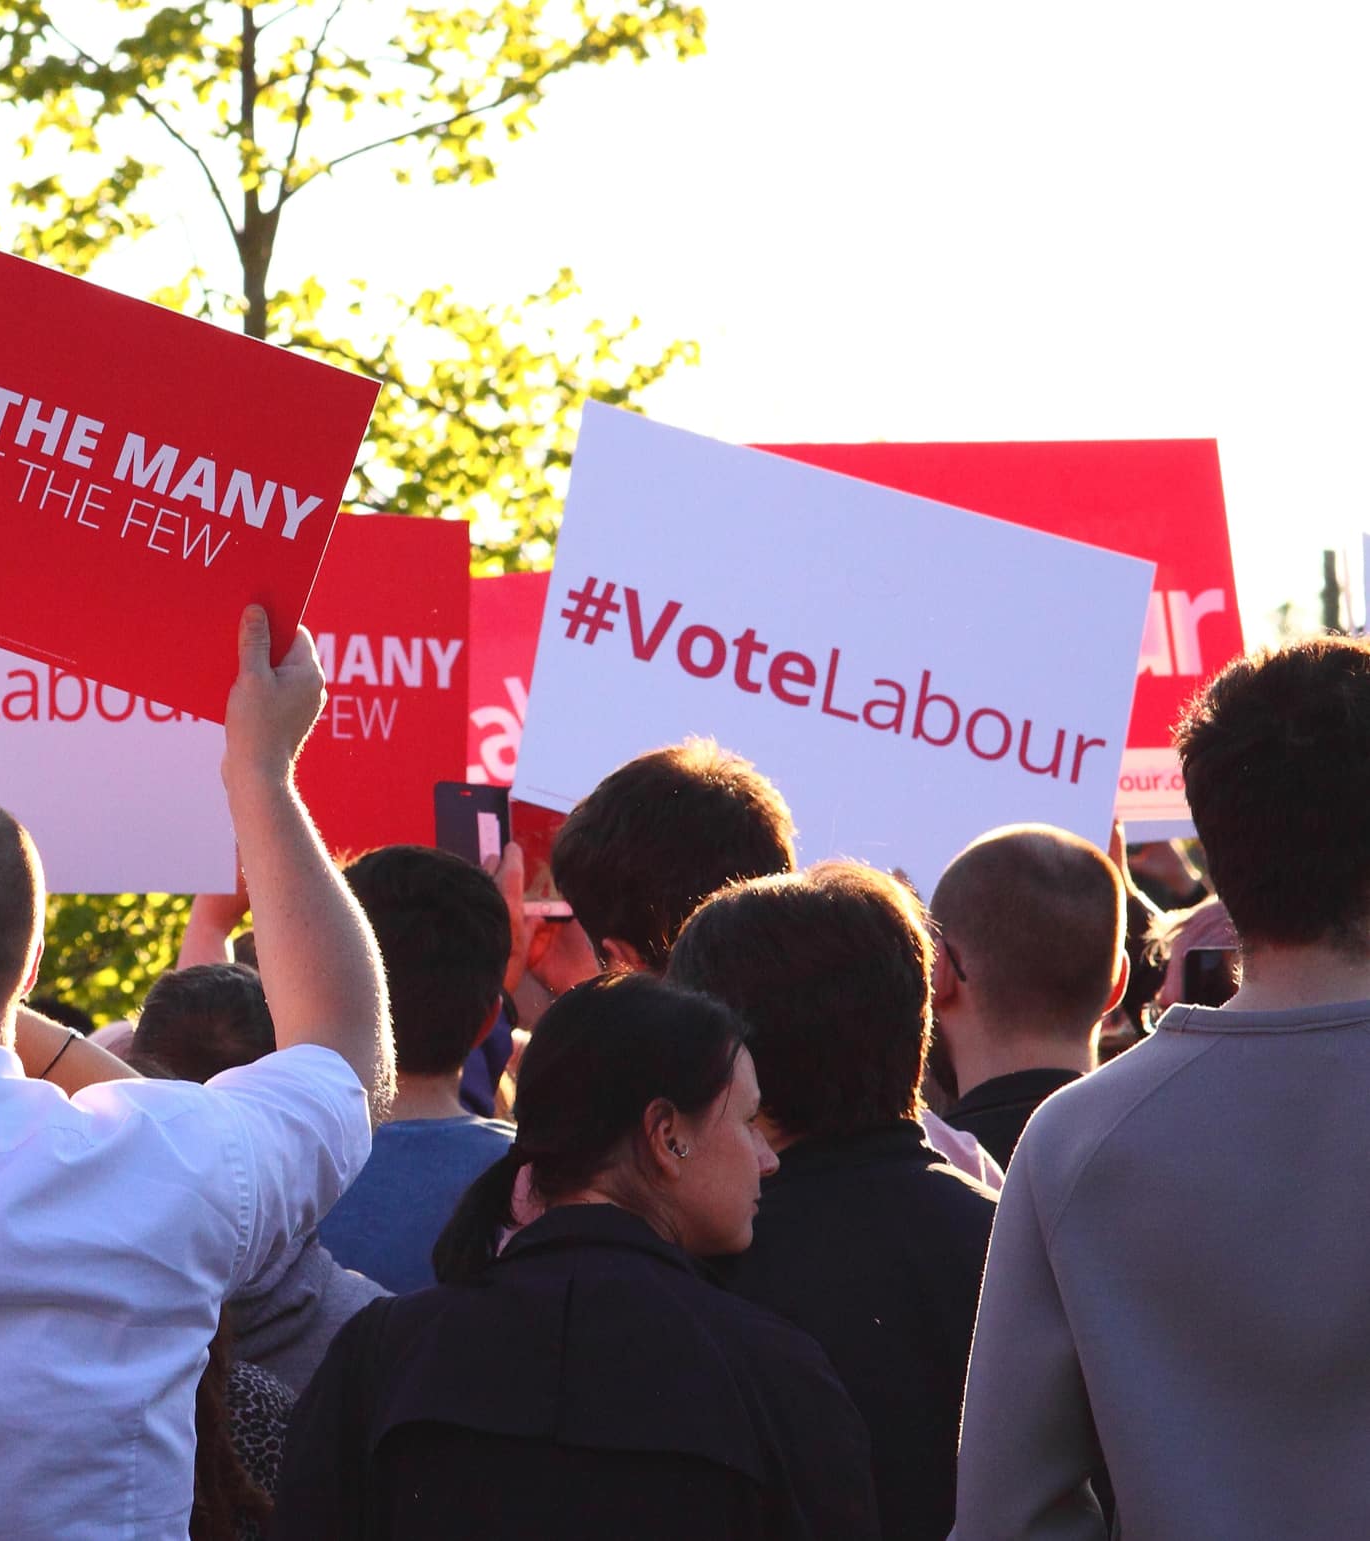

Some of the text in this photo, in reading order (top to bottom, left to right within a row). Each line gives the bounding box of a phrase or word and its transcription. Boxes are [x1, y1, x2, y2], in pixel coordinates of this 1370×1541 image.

[17, 458, 112, 530] THE
[121, 499, 231, 568] FEW
[113, 431, 324, 541] MANY
[318, 695, 399, 741] EW
[560, 576, 1107, 784] #VoteLabour
